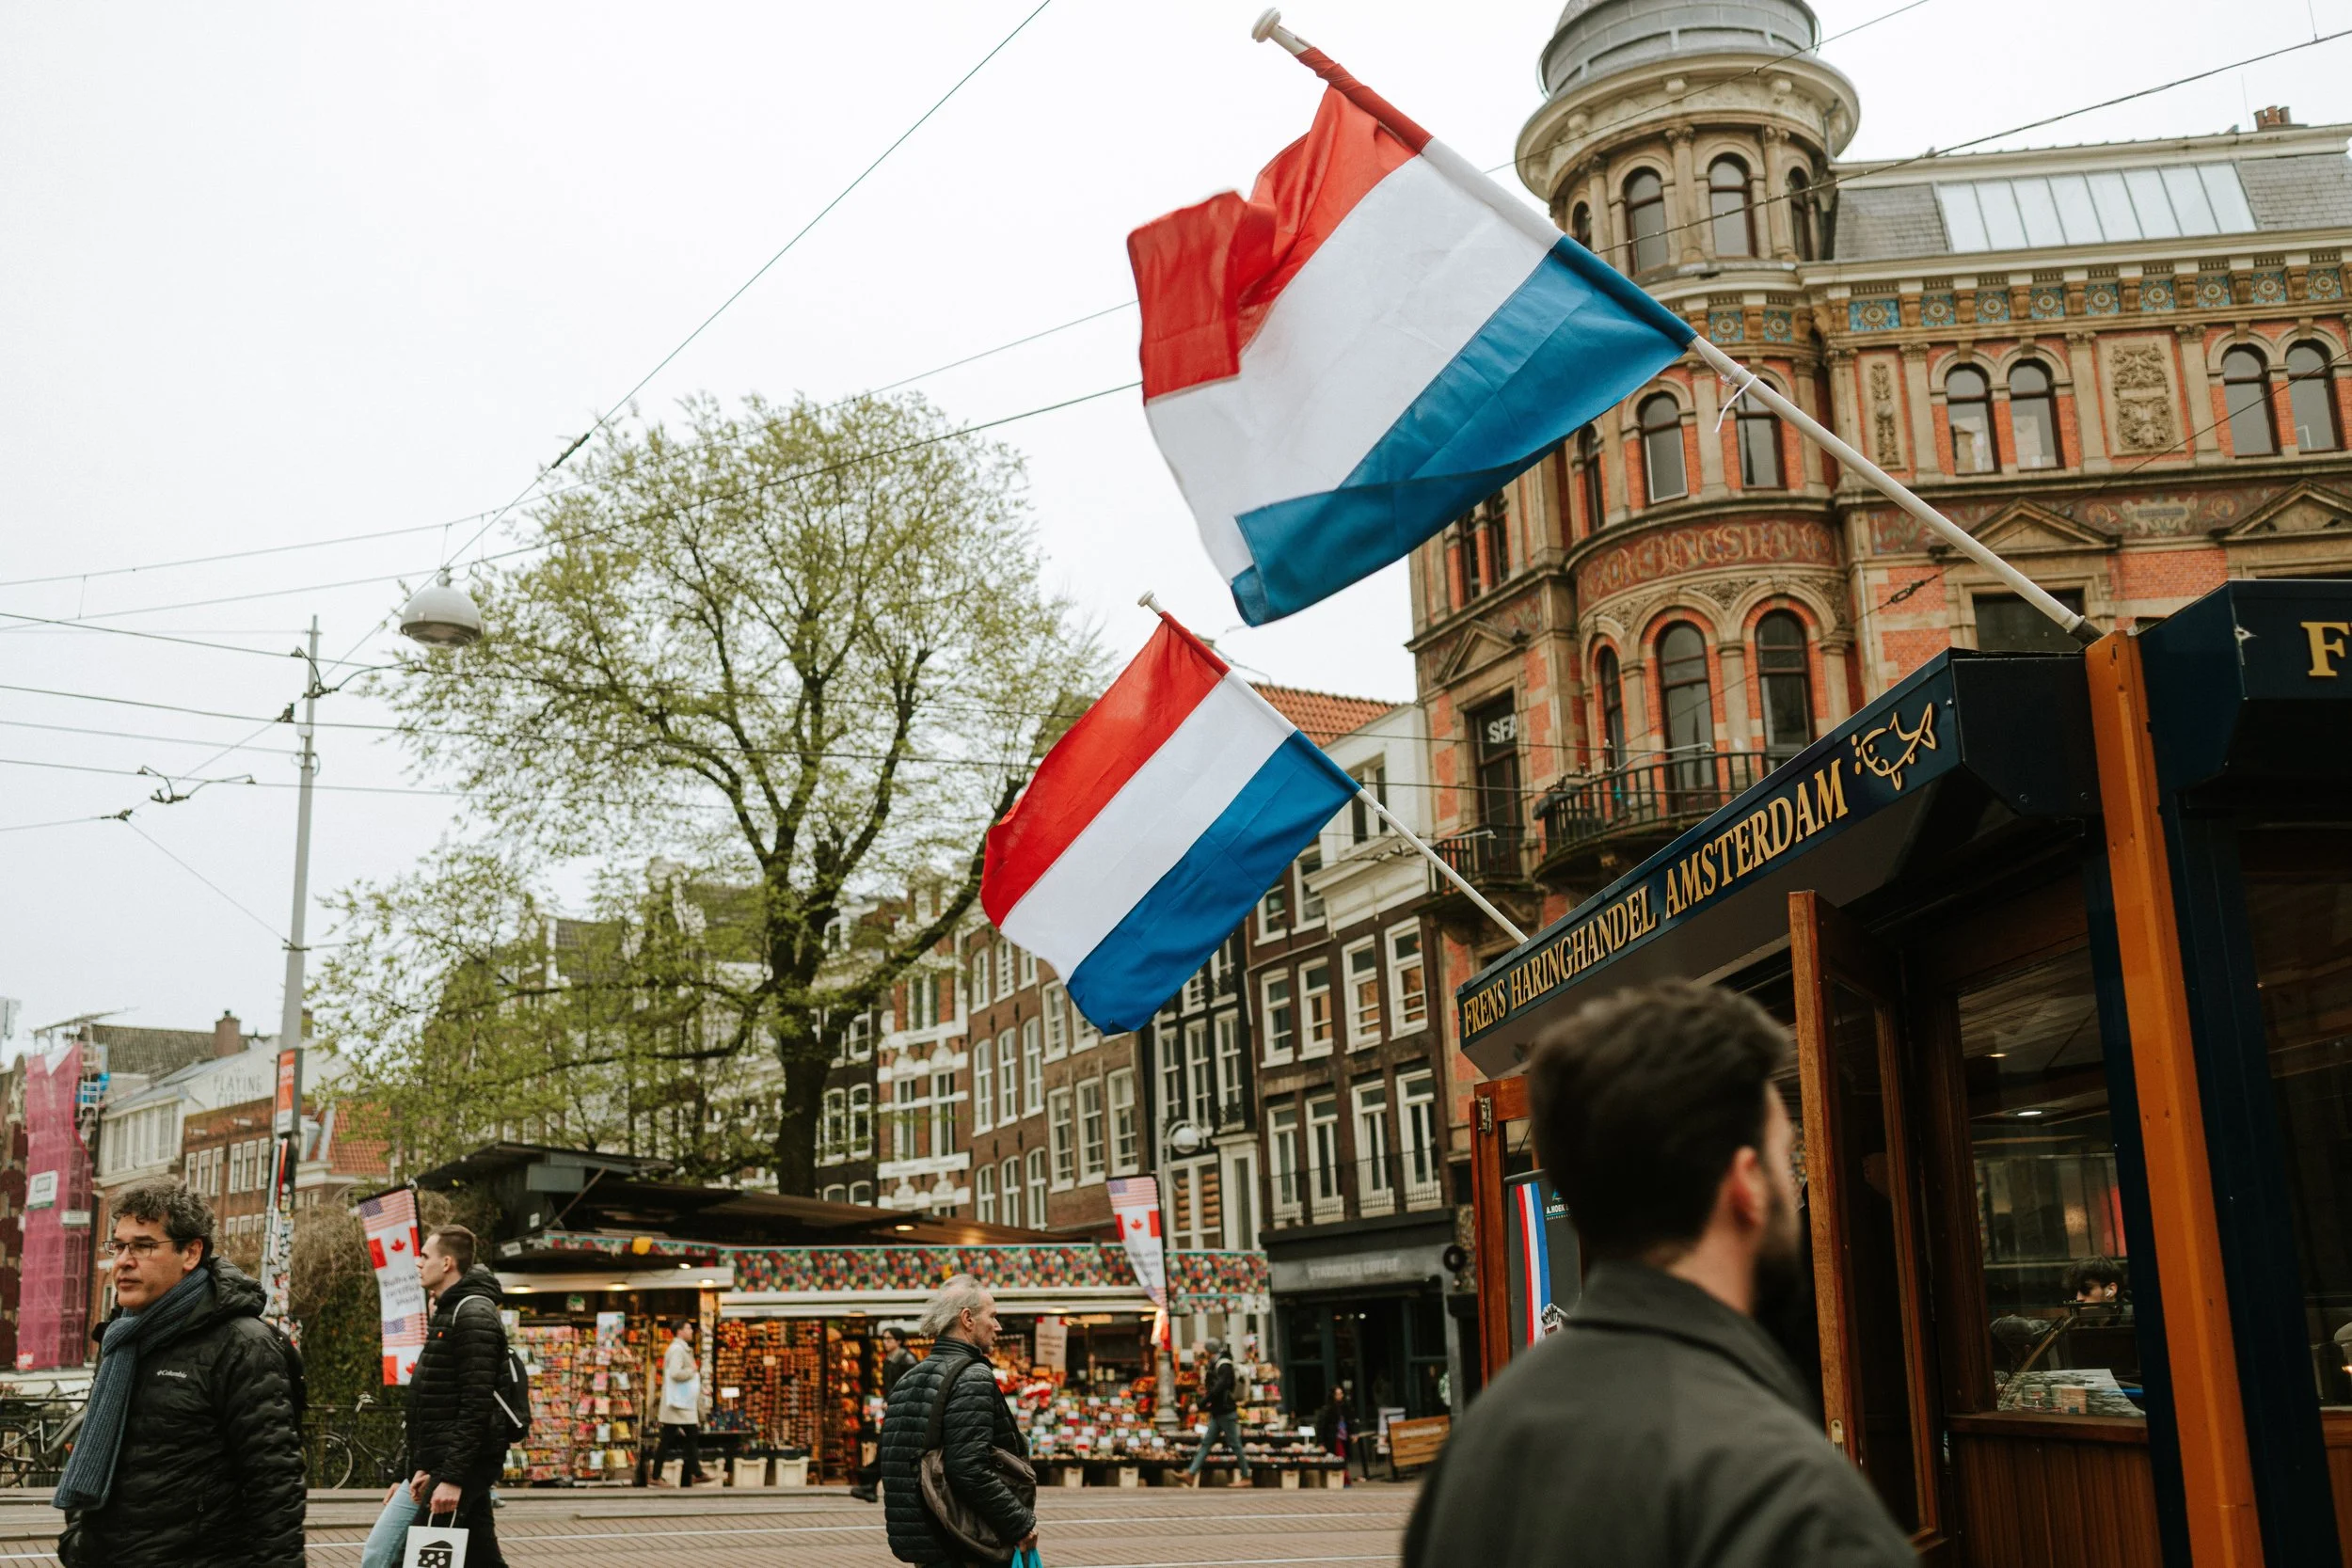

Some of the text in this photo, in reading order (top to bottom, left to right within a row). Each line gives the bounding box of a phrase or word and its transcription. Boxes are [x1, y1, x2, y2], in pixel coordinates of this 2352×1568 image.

[2299, 621, 2352, 676] F
[1463, 758, 1849, 1038] FRENS HARINGHANDEL AMSTERDAM
